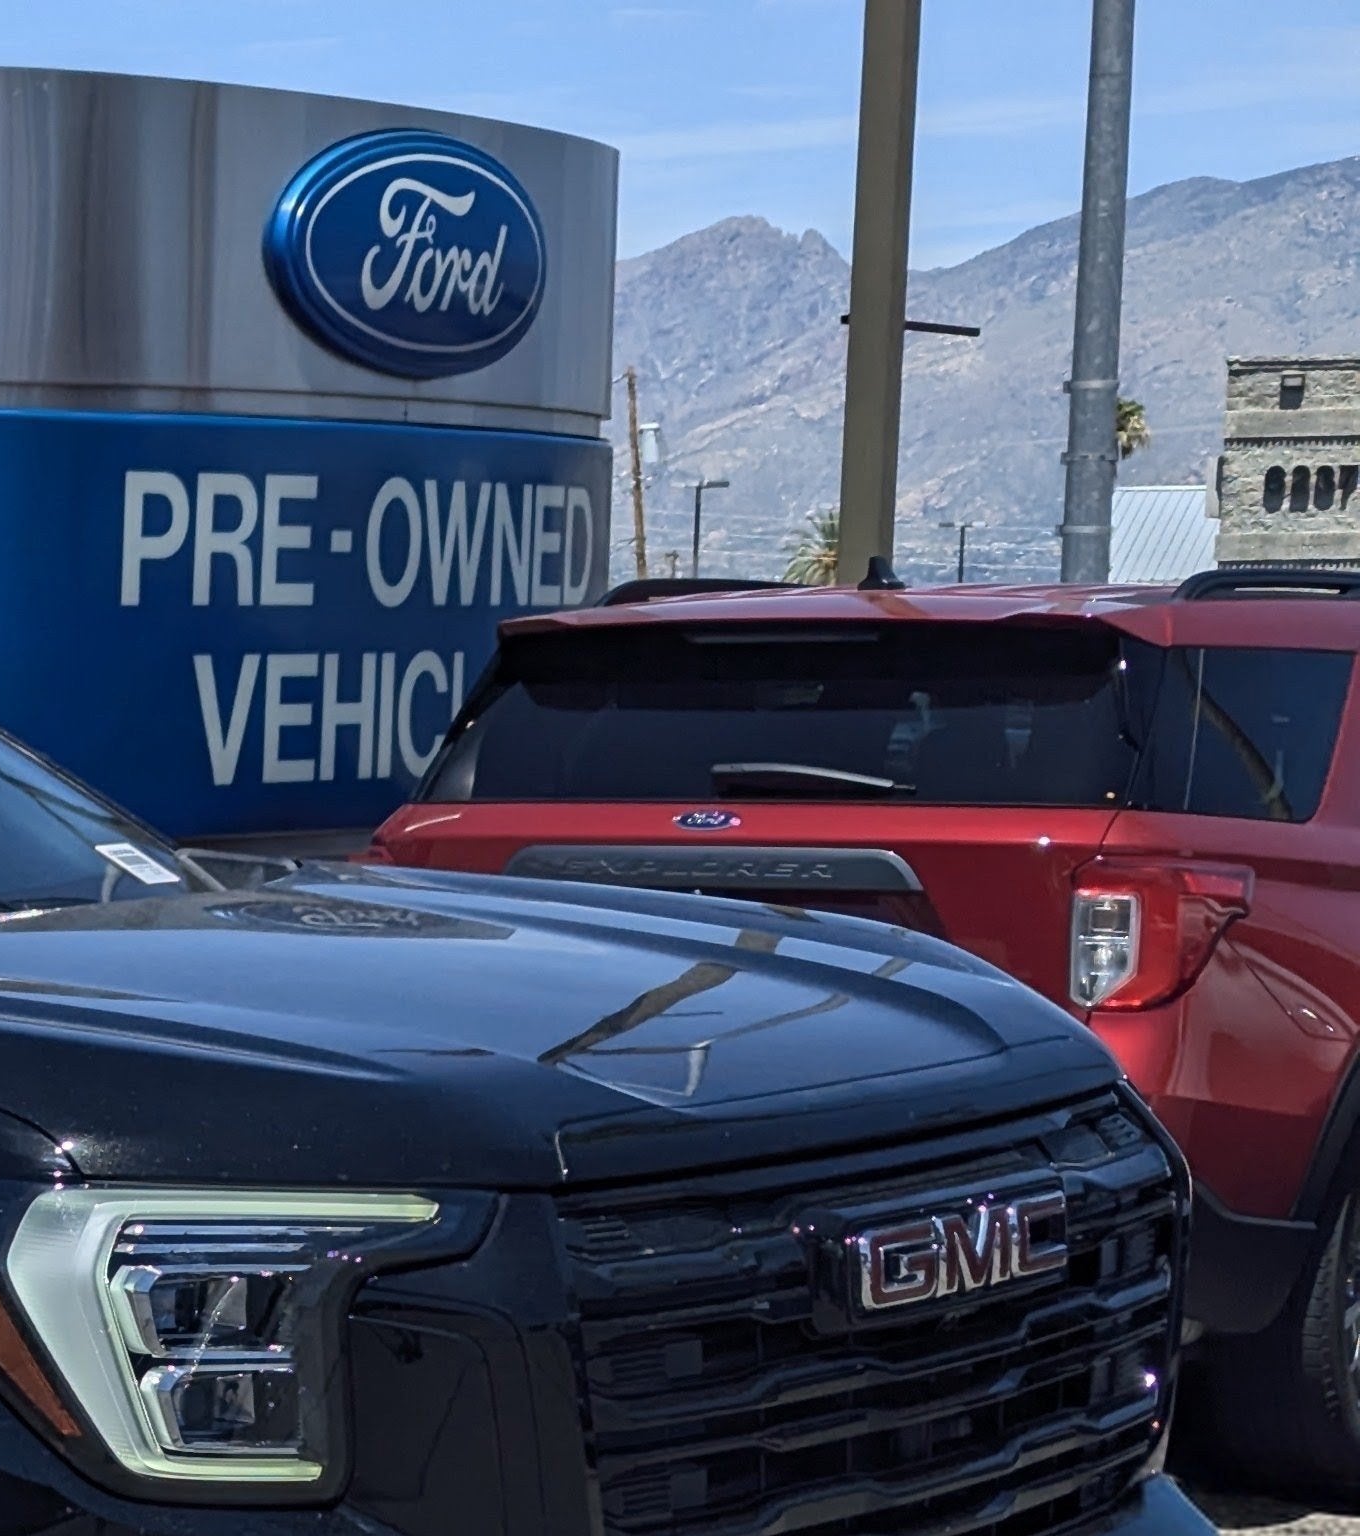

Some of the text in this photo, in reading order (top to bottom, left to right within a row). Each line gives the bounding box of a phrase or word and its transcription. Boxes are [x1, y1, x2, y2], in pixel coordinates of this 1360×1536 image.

[362, 177, 508, 315] Ford
[121, 470, 593, 607] PRE-OWNED
[859, 1189, 1068, 1311] GMC
